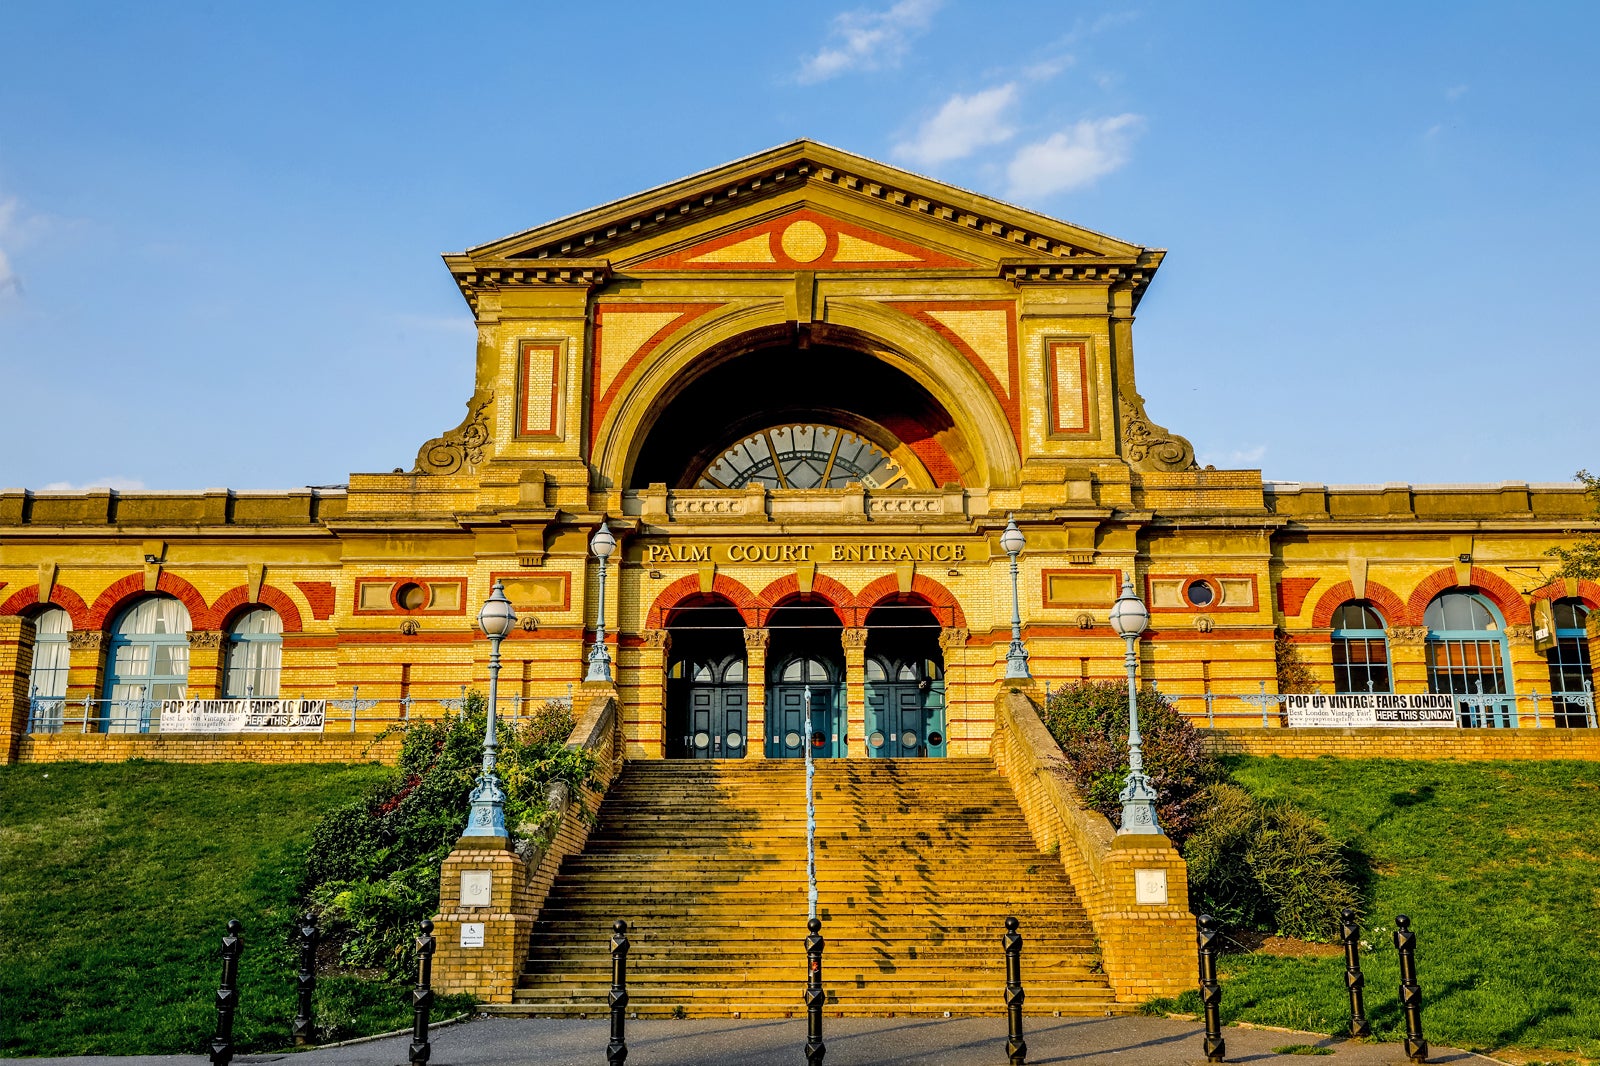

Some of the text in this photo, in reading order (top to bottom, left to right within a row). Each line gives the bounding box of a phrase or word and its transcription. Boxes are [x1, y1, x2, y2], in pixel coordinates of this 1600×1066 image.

[647, 544, 966, 562] PALM COURT ENTRANCE
[162, 700, 184, 714] POP
[249, 700, 280, 714] FAIRS
[282, 700, 324, 714] LODON
[1288, 695, 1453, 708] POP UP VINTAGE FAIRS LONDON
[178, 714, 200, 722] Loon
[1331, 709, 1355, 718] Vintage
[1376, 710, 1452, 720] HERE THIS SUNDAY
[245, 714, 268, 725] HERE
[270, 715, 288, 725] THIS
